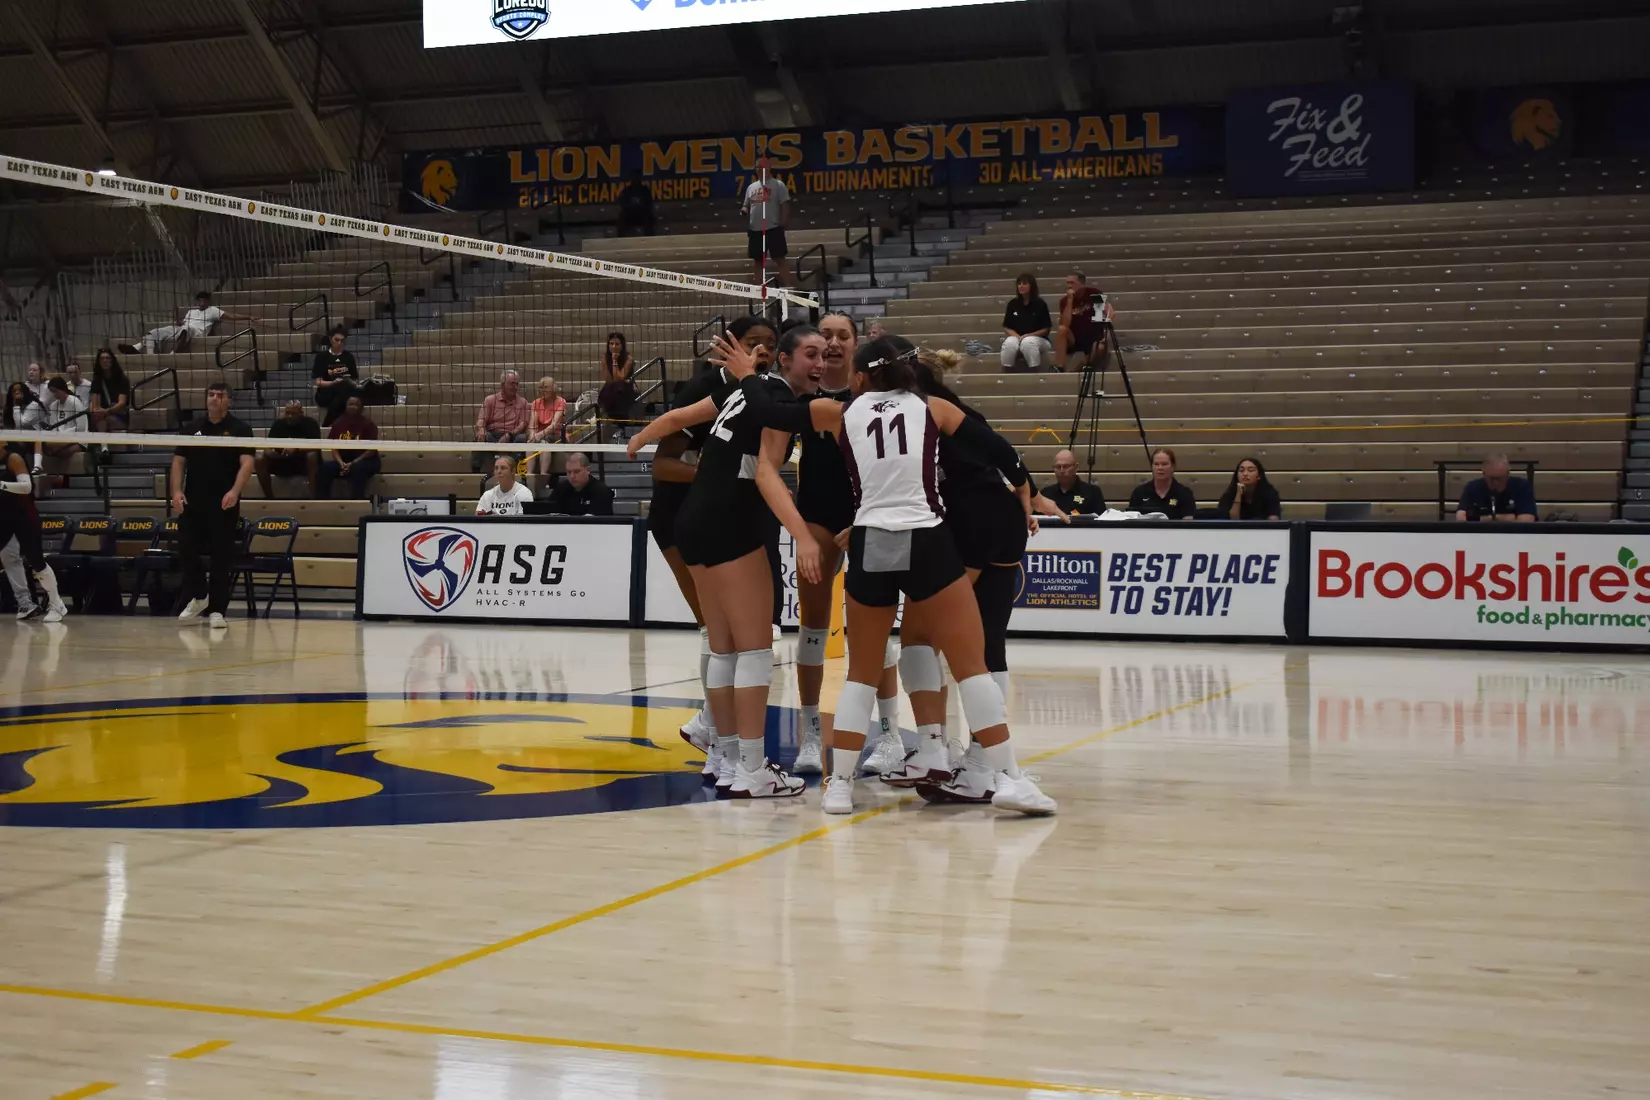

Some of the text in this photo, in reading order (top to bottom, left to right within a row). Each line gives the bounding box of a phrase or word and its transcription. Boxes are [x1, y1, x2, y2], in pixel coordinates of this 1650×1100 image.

[1266, 93, 1364, 143] Fix &
[507, 112, 1179, 183] LION MEN'S BASKETBALL
[1281, 133, 1371, 177] Feed
[7, 161, 78, 182] EAST TEXAS A&M
[803, 165, 934, 194] TOURNAMENTS
[979, 161, 1002, 184] 30
[1008, 153, 1163, 182] ALL-AMERICANS
[100, 178, 165, 196] EAST TEXAS A&M
[185, 191, 242, 210] EAST TEXAS A&M
[260, 206, 313, 223] EAST TEXAS A&M
[330, 218, 345, 228] EAST
[347, 220, 366, 231] TEXAS
[394, 228, 408, 238] EAST
[409, 231, 426, 241] TEXAS
[453, 239, 466, 248] EAST
[467, 241, 483, 250] TEXAS
[709, 388, 747, 442] 12
[867, 413, 908, 459] 11
[42, 520, 65, 529] IONS
[79, 520, 109, 529] LIONS
[122, 520, 152, 530] LIONS
[257, 520, 290, 530] LIONS
[477, 544, 567, 585] ASG
[1026, 554, 1095, 574] Hilton
[1107, 553, 1280, 584] BEST PLACE
[1049, 598, 1097, 606] ATHLETICS
[1109, 585, 1233, 617] TO STAY!
[1545, 606, 1650, 633] pharmac
